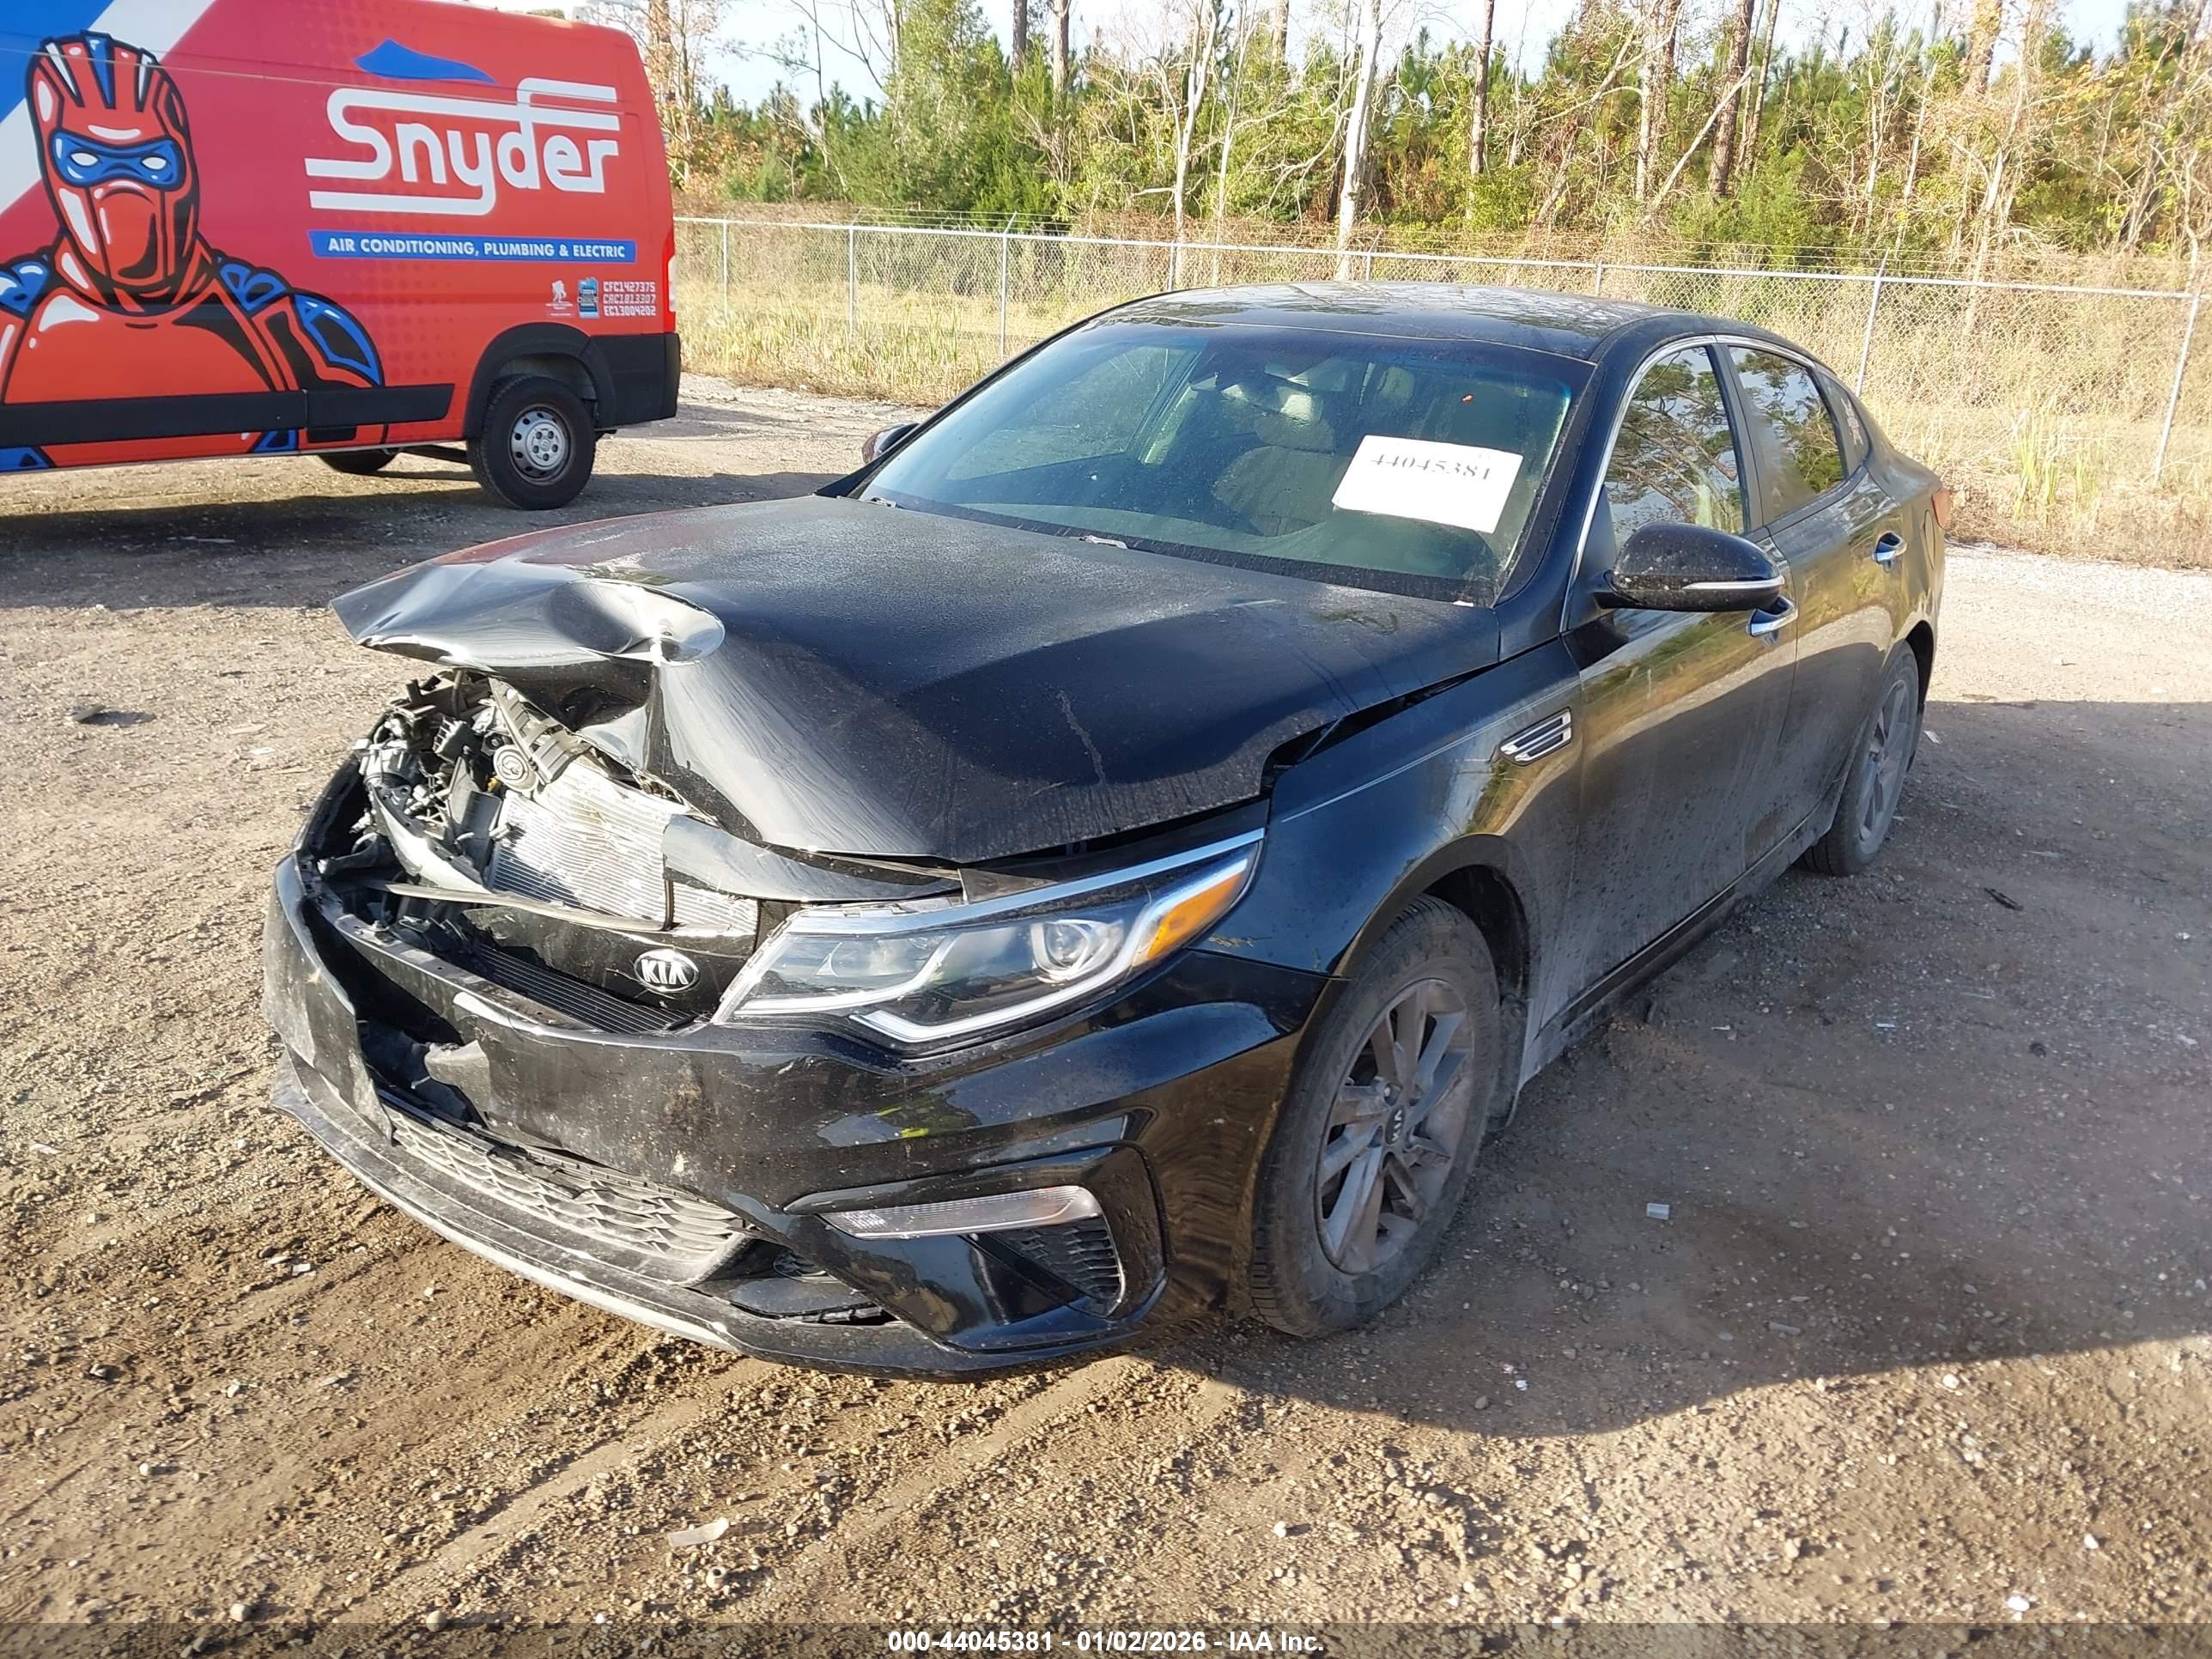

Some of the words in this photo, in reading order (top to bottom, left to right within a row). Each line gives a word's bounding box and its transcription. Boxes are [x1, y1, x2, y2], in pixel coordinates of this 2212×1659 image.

[304, 77, 620, 216] Snyder
[328, 238, 356, 252] AIR
[360, 239, 479, 257] CONDITIONING,
[483, 242, 555, 257] PLUMBING
[559, 245, 568, 257] &
[573, 245, 625, 258] ELECTRIC
[1370, 453, 1491, 480] 44045381
[641, 958, 689, 985] KIA
